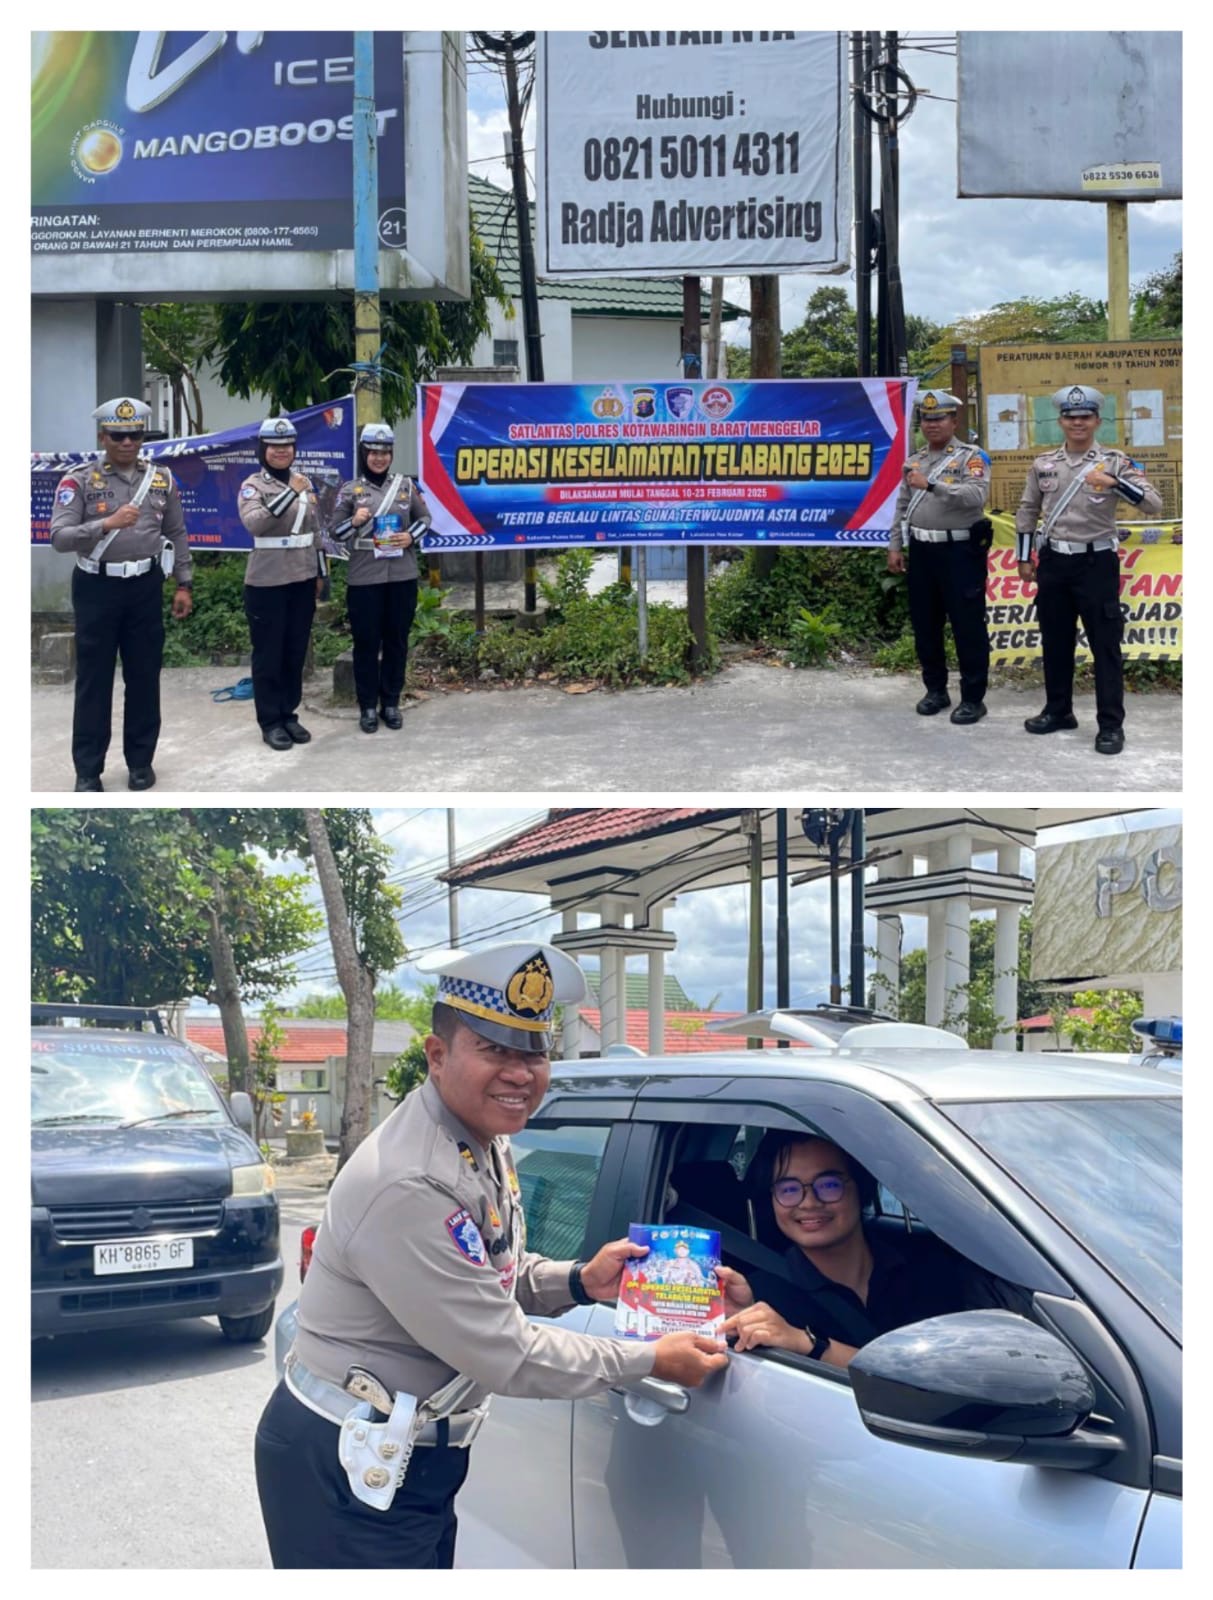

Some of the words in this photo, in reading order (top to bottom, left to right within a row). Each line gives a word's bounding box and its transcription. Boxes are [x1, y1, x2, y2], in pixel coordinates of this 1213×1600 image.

[274, 57, 354, 86] ICE
[636, 91, 734, 120] Hubungi
[133, 109, 397, 160] MANGOBOOST
[584, 136, 652, 182] 0821
[660, 134, 727, 179] 5011
[733, 131, 800, 176] 4311
[1083, 171, 1107, 181] 0822
[561, 201, 643, 248] Radja
[650, 196, 822, 243] Advertising
[91, 229, 136, 239] LAYANAN
[138, 228, 188, 238] BERHENTI
[191, 227, 241, 237] MEROKOK
[33, 242, 68, 251] ORANG
[70, 241, 80, 250] DI
[82, 240, 118, 249] BAWAH
[120, 240, 131, 249] 21
[134, 240, 168, 248] TAHUN
[173, 239, 194, 248] DAN
[196, 238, 259, 248] PEREMPUAN
[261, 237, 294, 246] HAMIL
[997, 353, 1051, 362] PERATURAN
[1096, 350, 1150, 358] KABUPATEN
[1074, 362, 1108, 370] NOMOR
[1126, 360, 1156, 369] TAHUN
[510, 424, 573, 439] SATLANTAS
[576, 423, 619, 438] POLRES
[622, 421, 706, 438] KOTAWARINGIN
[710, 421, 746, 436] BARAT
[750, 421, 820, 436] MENGGELAR
[457, 447, 547, 480] OPERASI
[551, 444, 700, 479] KESELAMATAN
[703, 443, 812, 476] TELABANG
[815, 443, 871, 476] 2025
[87, 491, 114, 501] CIPTO
[560, 489, 617, 500] DILAKSANAKAN
[620, 489, 644, 499] MULAI
[646, 488, 680, 499] TANGGAL
[683, 488, 705, 498] 10-23
[707, 487, 745, 498] FEBRUARI
[747, 487, 767, 497] 2025
[547, 510, 599, 525] BERLALU
[601, 510, 641, 523] LINTAS
[644, 509, 675, 522] GUNA
[680, 508, 764, 523] TERWUJUDNYA
[767, 508, 797, 522] ASTA
[99, 1247, 118, 1264] KH
[124, 1244, 161, 1262] 8865
[169, 1241, 186, 1259] GF
